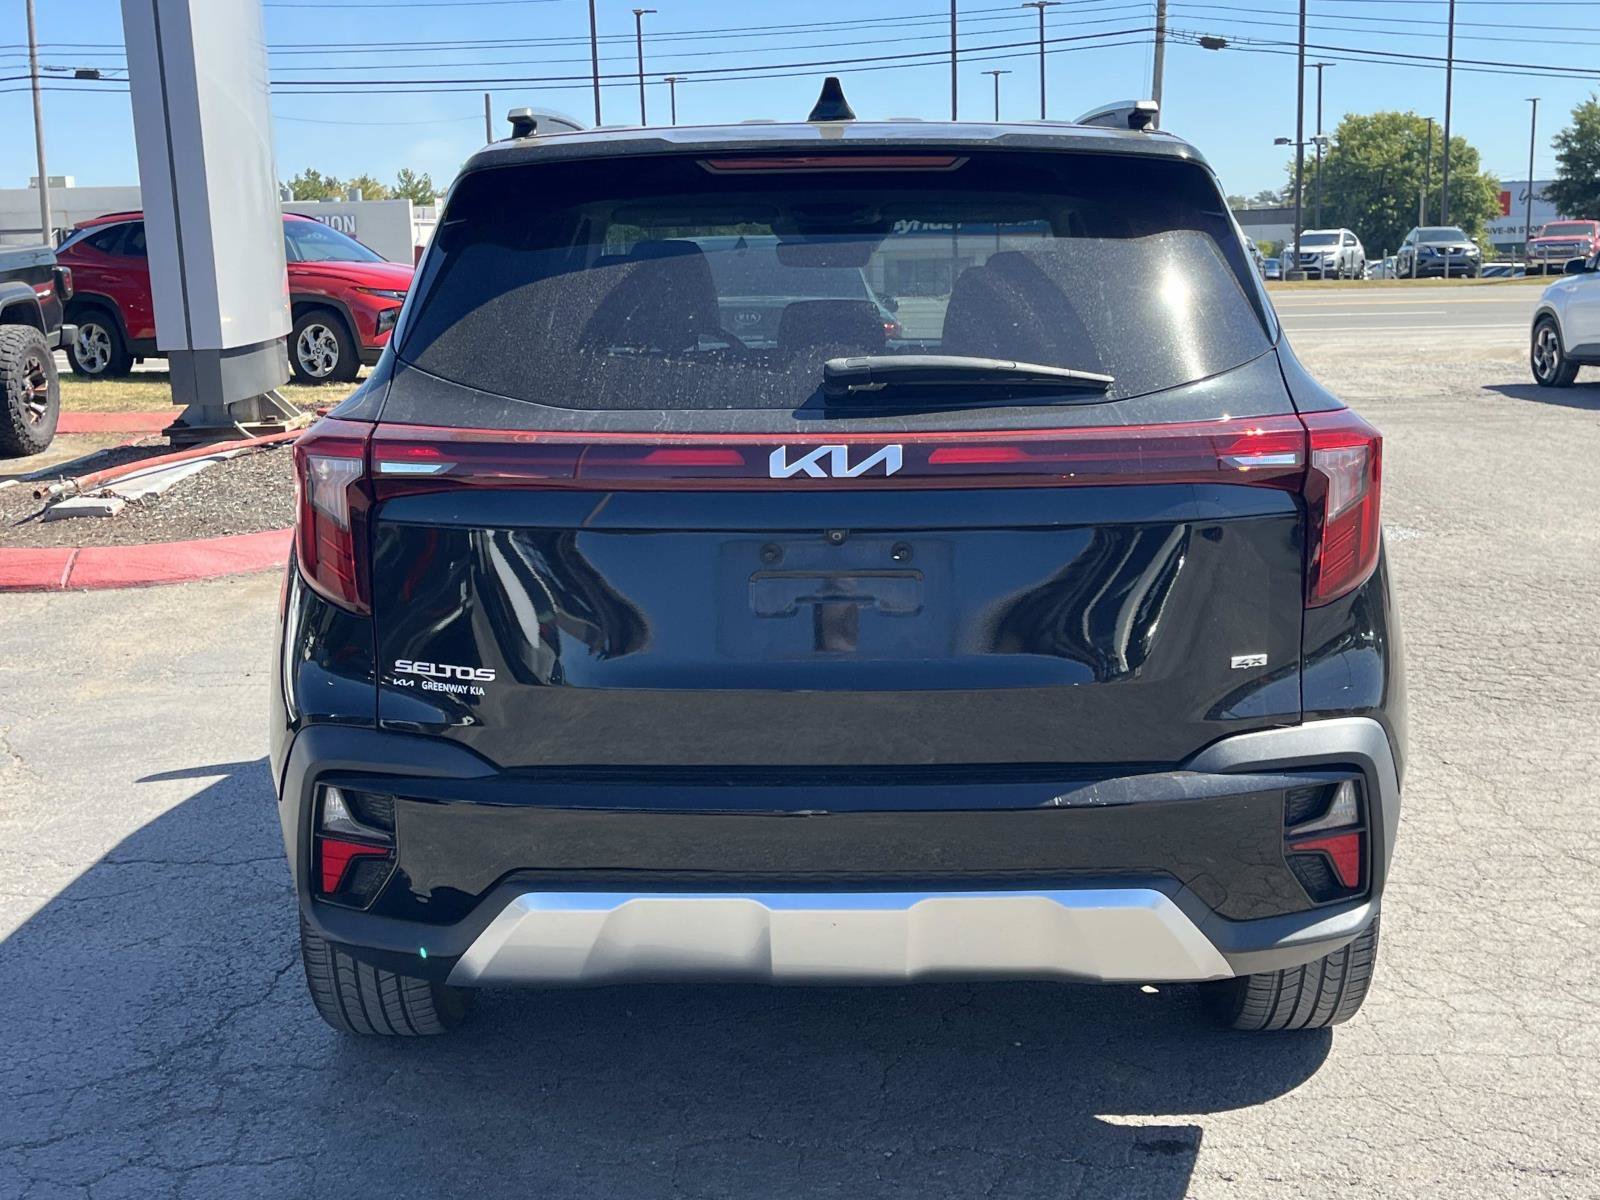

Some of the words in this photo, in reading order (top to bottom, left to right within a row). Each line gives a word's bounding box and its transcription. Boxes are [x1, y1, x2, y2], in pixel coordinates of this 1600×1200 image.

[769, 444, 903, 478] KIA
[394, 659, 496, 682] SELTOS
[393, 678, 415, 687] KIA
[421, 680, 468, 695] GREENWAY
[470, 686, 486, 696] KIA
